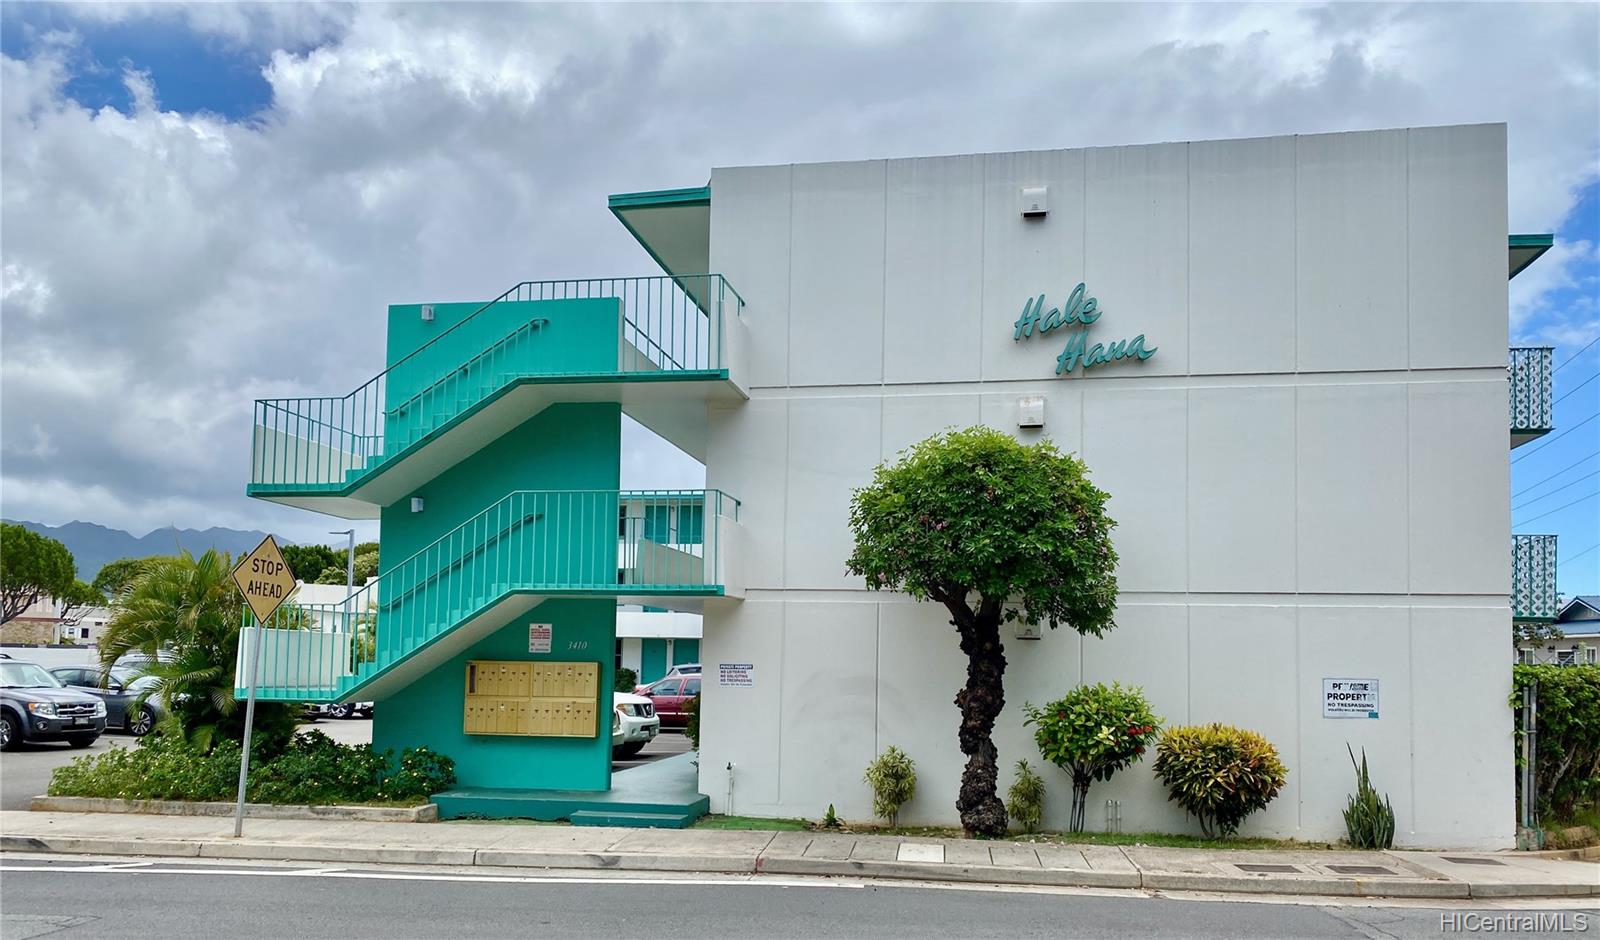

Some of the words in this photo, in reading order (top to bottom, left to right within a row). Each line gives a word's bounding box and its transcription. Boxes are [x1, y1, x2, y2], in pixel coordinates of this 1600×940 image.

[1014, 282, 1102, 341] Hale
[1055, 330, 1158, 375] Hana
[252, 558, 284, 576] STOP
[247, 580, 283, 599] AHEAD
[567, 641, 588, 650] 3410
[1327, 692, 1376, 701] PROPERT
